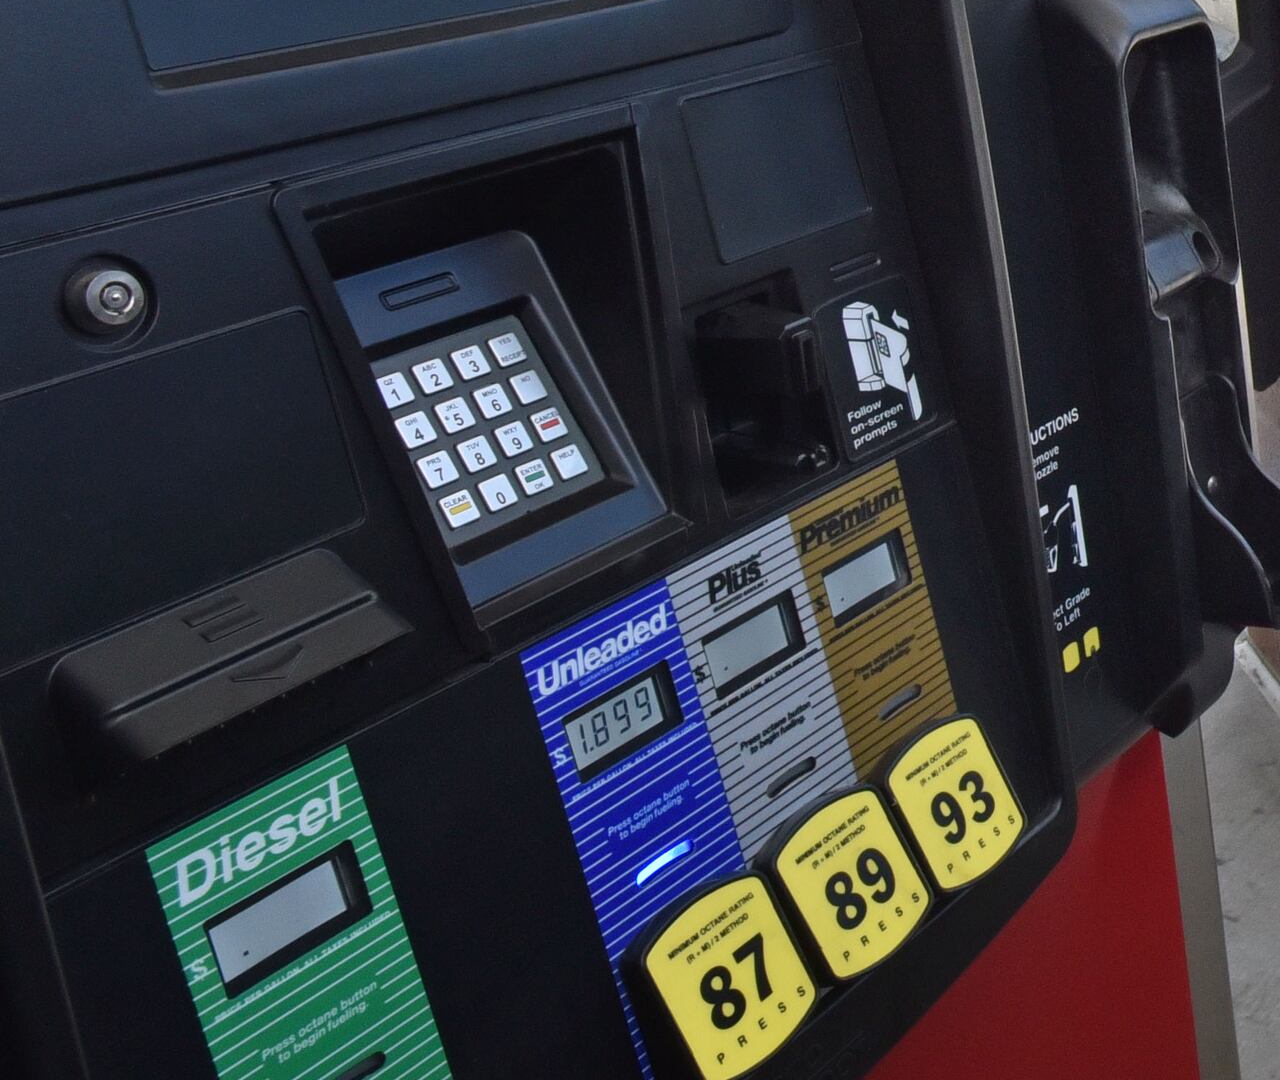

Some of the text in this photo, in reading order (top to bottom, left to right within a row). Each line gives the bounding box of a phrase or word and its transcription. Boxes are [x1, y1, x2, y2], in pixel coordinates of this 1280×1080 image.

[460, 350, 474, 359] DEF
[422, 363, 437, 372] ABC
[469, 360, 480, 373] 3
[430, 374, 442, 387] 2
[390, 388, 401, 402] 1
[482, 388, 498, 398] MNO
[445, 402, 459, 412] JKL
[491, 399, 502, 412] 6
[847, 400, 881, 422] Follow
[454, 413, 465, 426] 5
[851, 403, 903, 434] on-screen
[414, 427, 425, 442] 4
[503, 425, 518, 437] WXY
[854, 420, 898, 450] prompts
[512, 437, 523, 450] 9
[475, 452, 486, 466] 8
[558, 449, 575, 460] HELP
[434, 467, 444, 481] 7
[520, 463, 542, 476] ENTER
[444, 494, 467, 509] CLEAR
[496, 491, 507, 505] 0
[800, 485, 899, 554] Premium
[708, 561, 761, 605] Plus
[1065, 586, 1091, 611] Grade
[1064, 608, 1081, 626] Left
[538, 602, 667, 696] Unleaded
[553, 686, 650, 766] $ 1.899
[929, 745, 952, 764] OCTANE
[945, 748, 968, 768] METHOD
[607, 779, 690, 837] Press octane button
[619, 795, 685, 840] to begin fueling.
[931, 770, 995, 845] 93
[176, 777, 342, 908] Diesel
[795, 805, 870, 865] MINIMUM OCTANE RATING
[841, 824, 866, 847] METHOD
[825, 847, 896, 930] 89
[667, 892, 754, 960] MINIMUM OCTANE RATING
[720, 912, 749, 938] METHOD
[700, 932, 773, 1030] 87
[261, 981, 377, 1061] Press octane button
[277, 1002, 369, 1063] to begin fueling.
